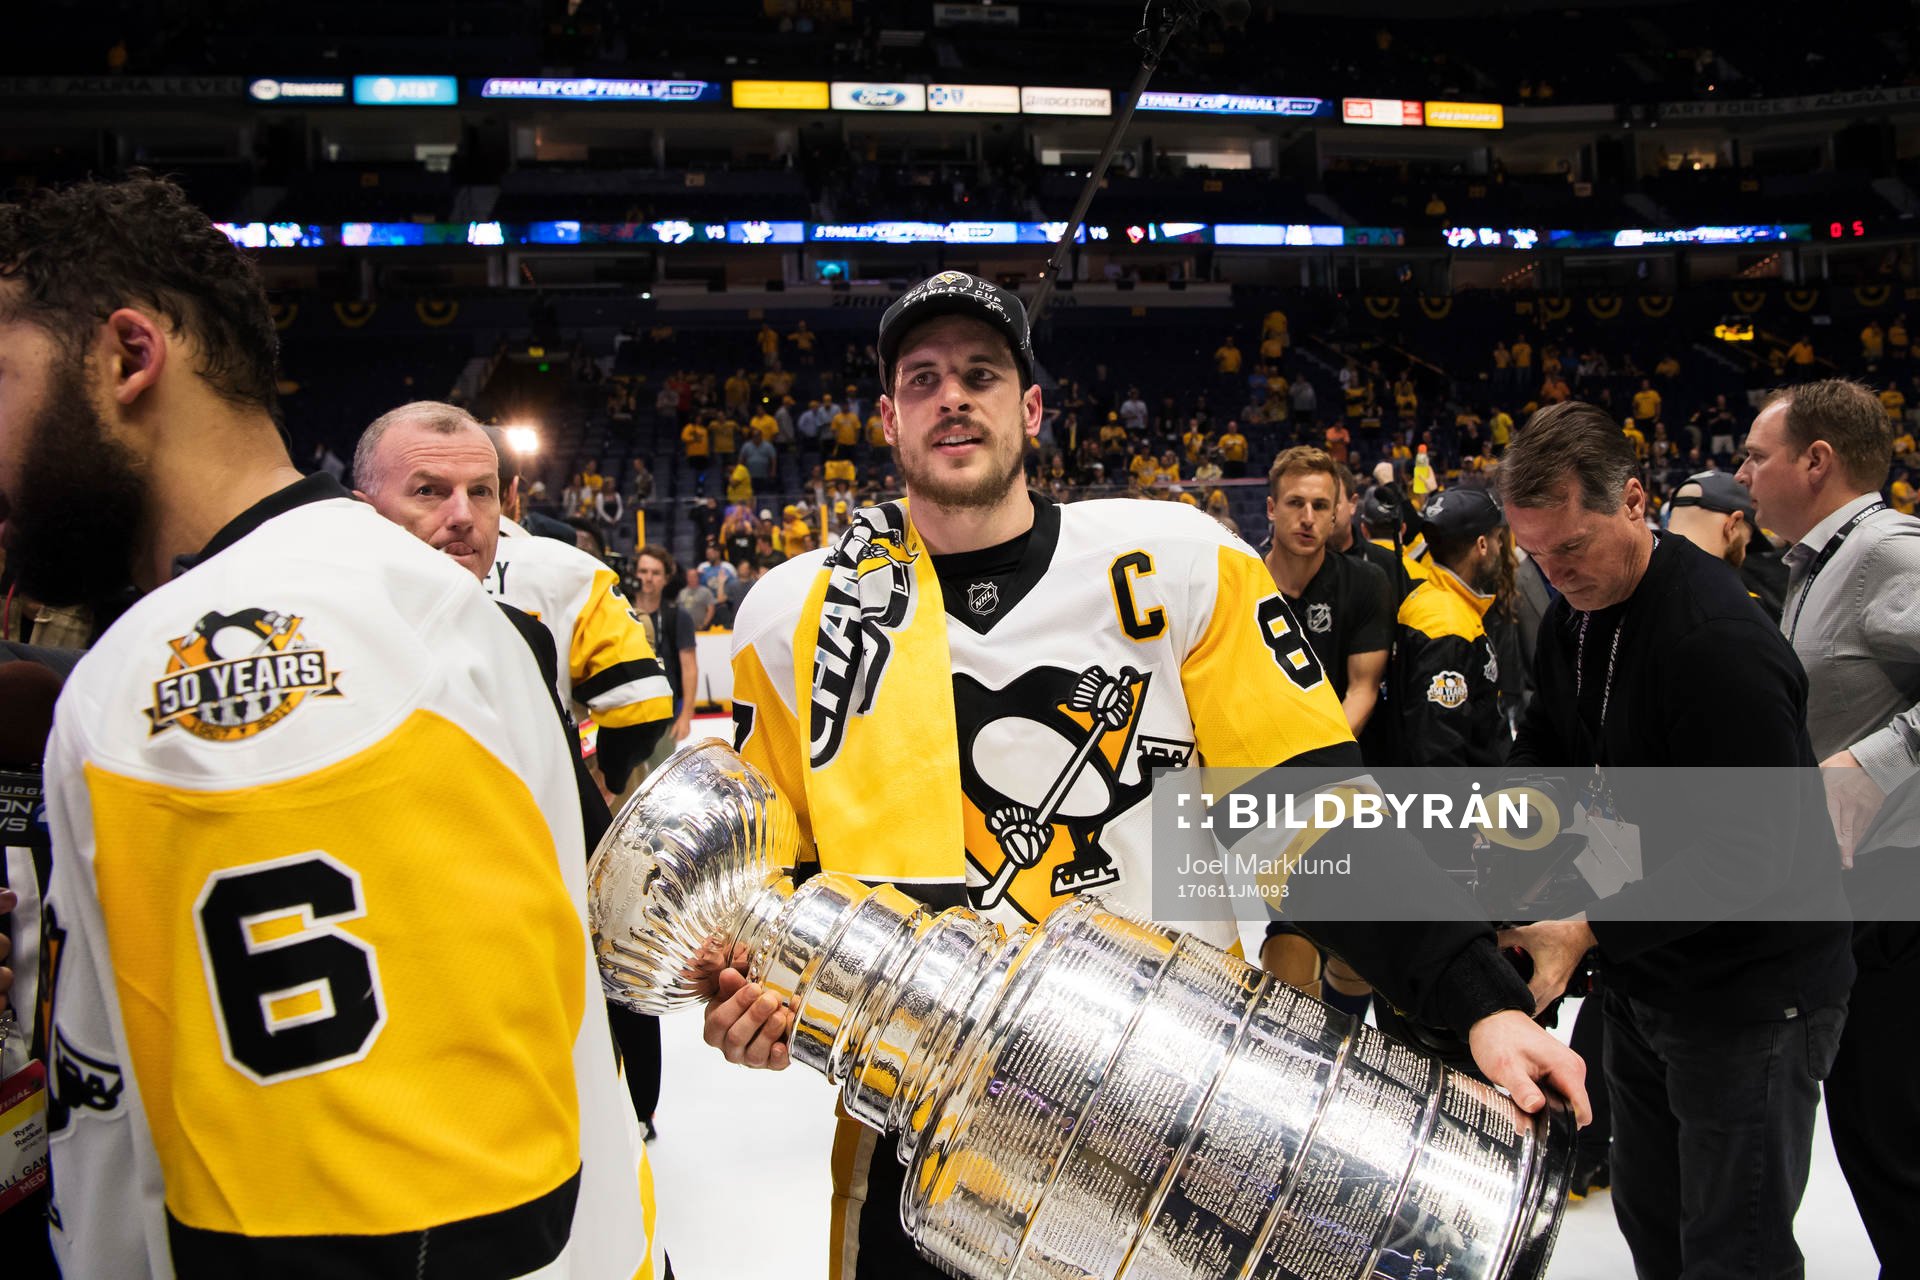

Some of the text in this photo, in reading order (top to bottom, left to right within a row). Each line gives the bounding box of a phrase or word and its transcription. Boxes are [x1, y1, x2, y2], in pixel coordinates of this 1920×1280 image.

[398, 81, 439, 98] AT&T
[489, 80, 559, 95] STANLEY
[560, 80, 599, 97] CUP
[597, 82, 651, 97] FINAL
[859, 88, 899, 107] Ford
[1025, 94, 1108, 110] BRIDGESTONE
[1137, 92, 1199, 108] STANLEY
[1198, 94, 1231, 110] CUP
[1228, 97, 1275, 112] FINAL
[705, 225, 726, 239] VS
[1089, 226, 1109, 240] VS
[1830, 220, 1864, 237] 0 5
[903, 286, 1002, 308] STANLEY CUP
[1852, 501, 1882, 526] STANLEY
[975, 590, 993, 609] NHL
[1109, 548, 1169, 643] C
[1254, 591, 1325, 693] 8
[159, 651, 322, 714] 50 YEARS
[191, 849, 389, 1086] 6
[13, 1122, 35, 1139] Ryan
[0, 1174, 21, 1194] ALL
